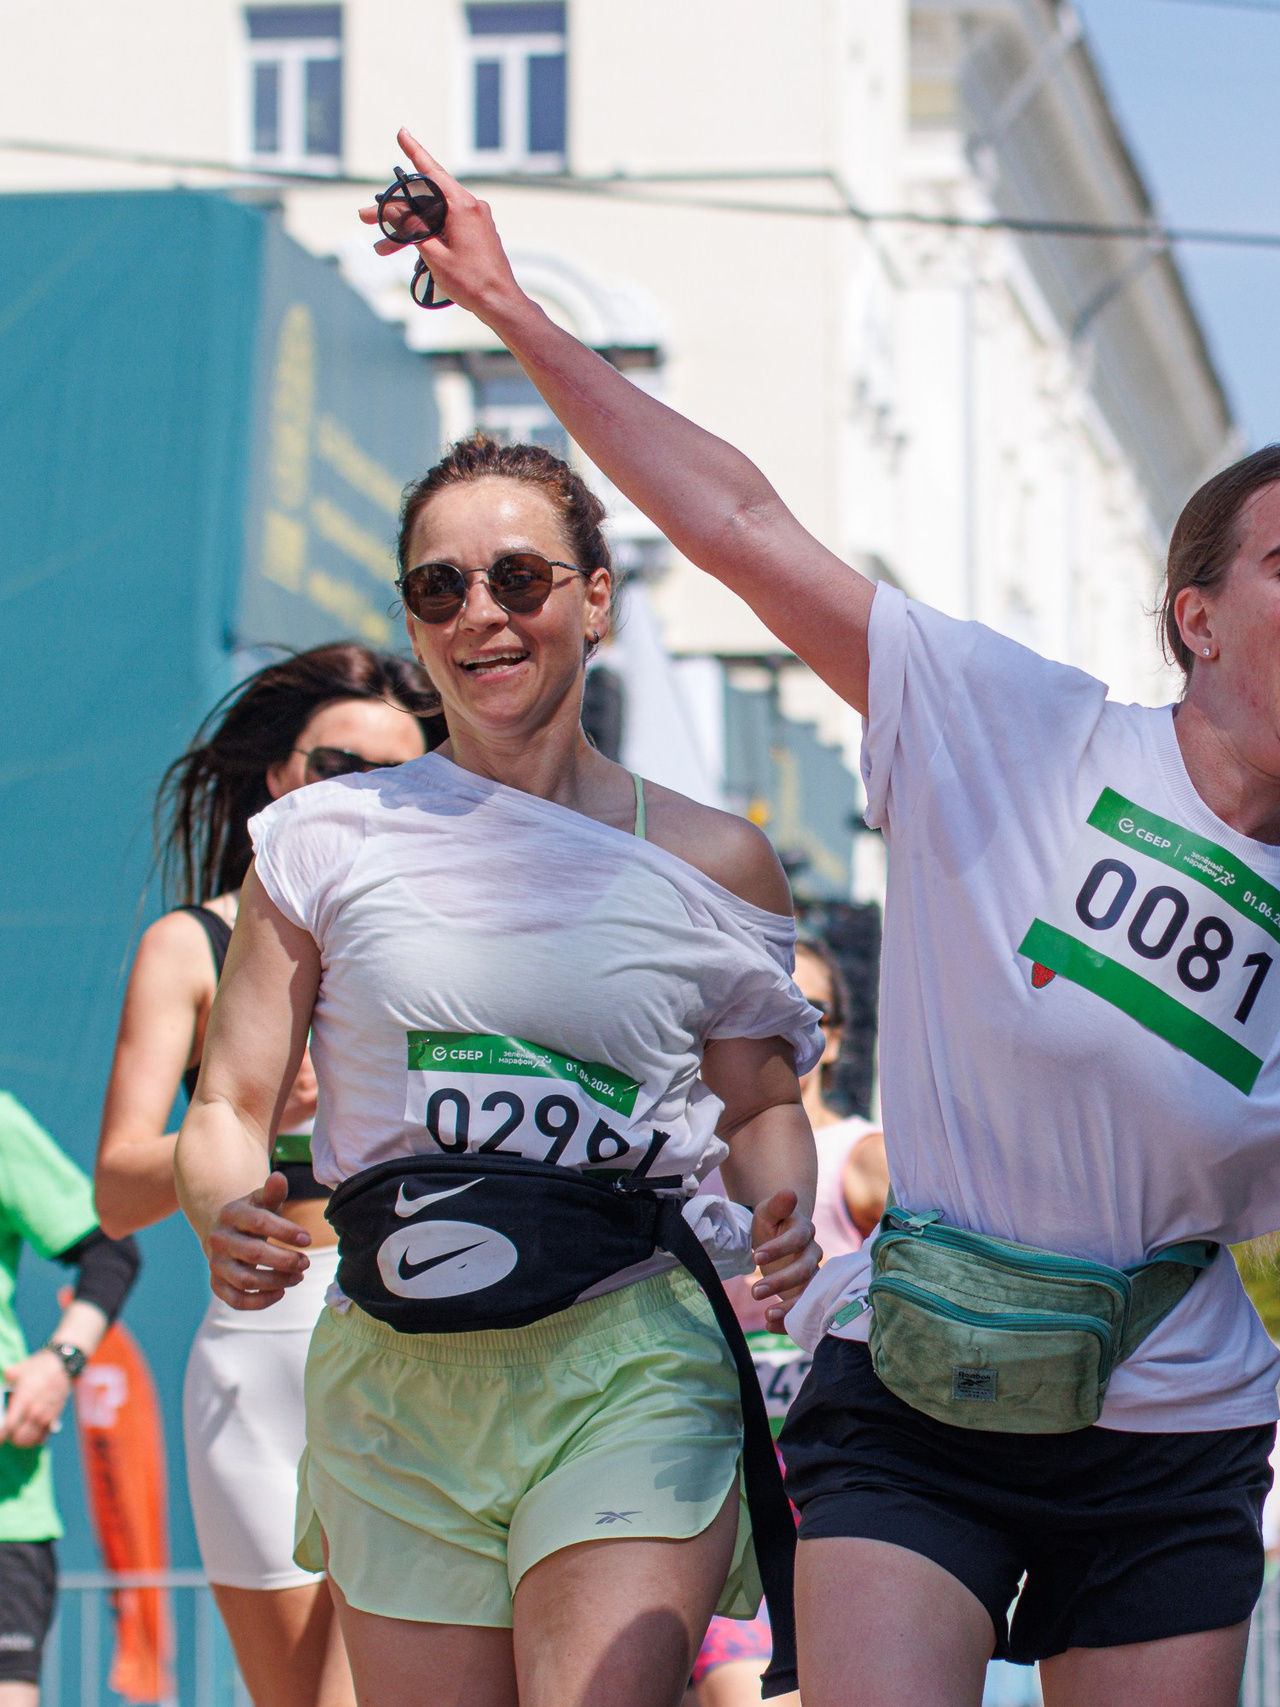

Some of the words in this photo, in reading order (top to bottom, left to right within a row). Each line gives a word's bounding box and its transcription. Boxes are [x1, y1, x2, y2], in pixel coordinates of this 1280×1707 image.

[1135, 828, 1171, 849] СБЕР
[1183, 855, 1218, 878] марафон
[1190, 851, 1224, 873] зелёный
[1075, 858, 1274, 1026] 0081
[450, 1049, 484, 1061] СБЕР
[498, 1057, 533, 1066] марафон
[566, 1062, 615, 1098] 01.06.2024
